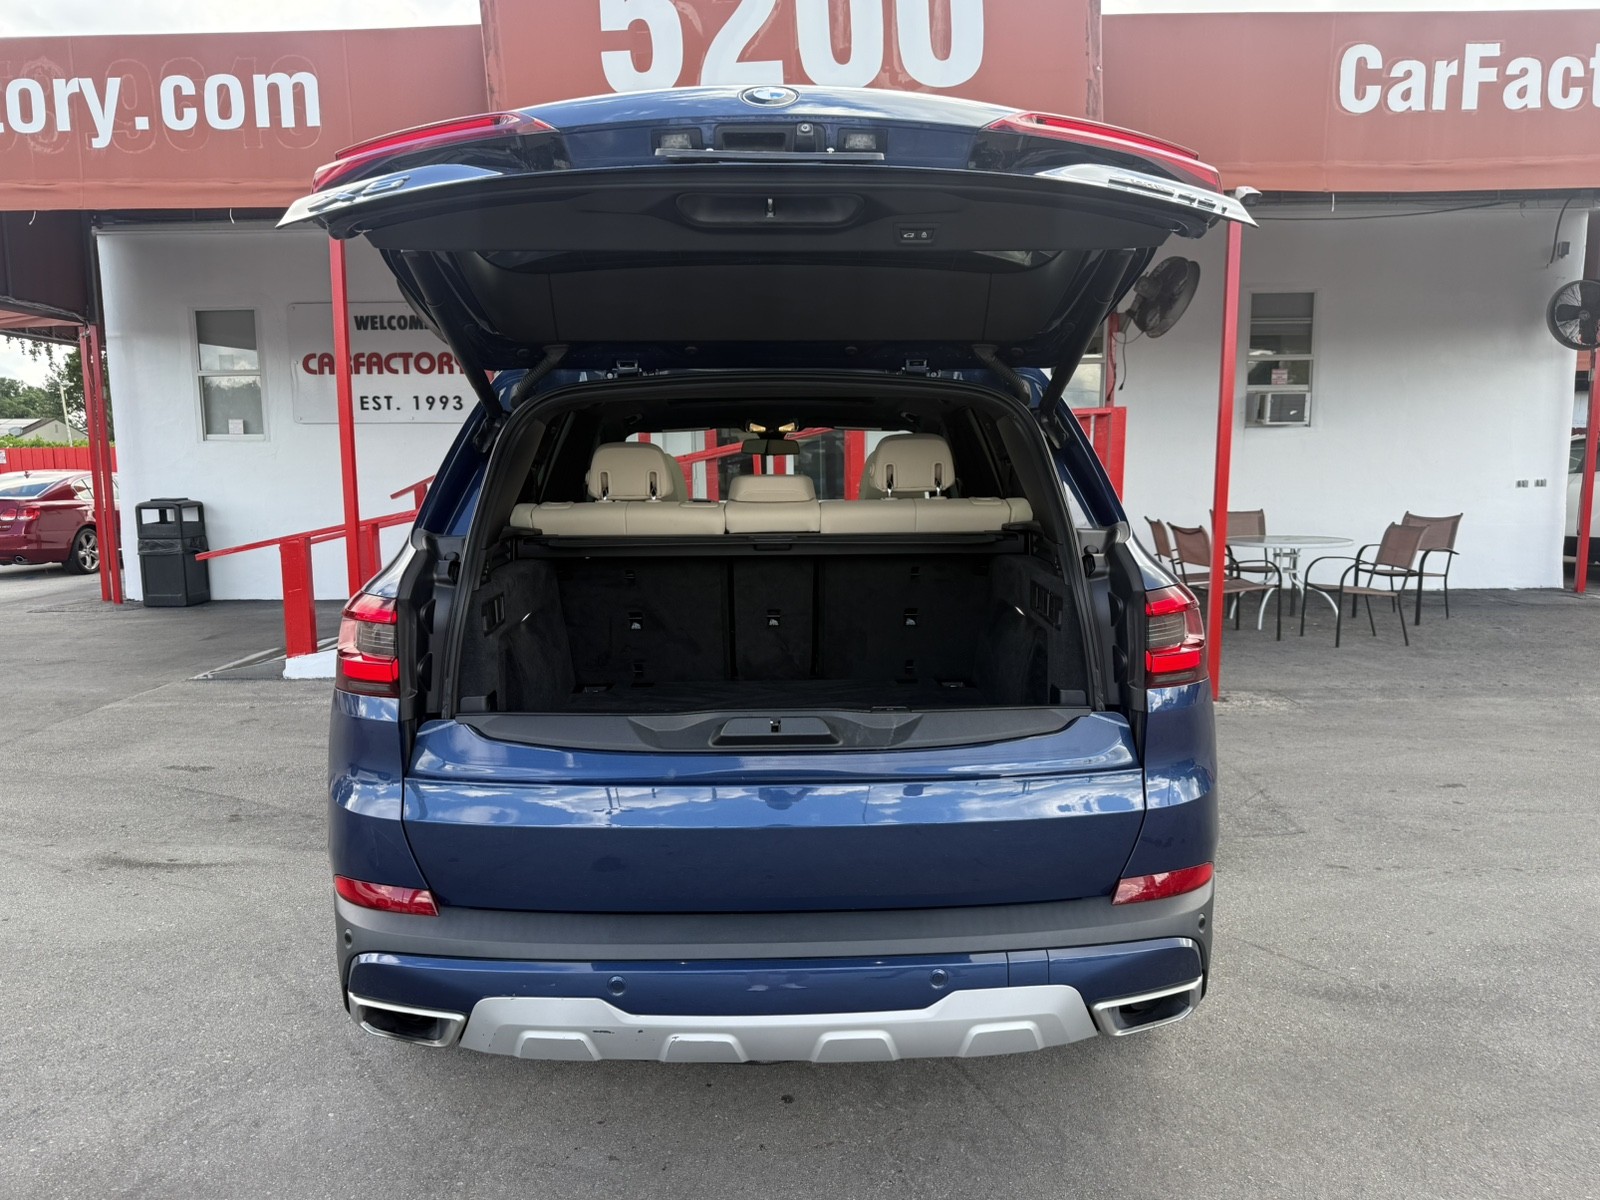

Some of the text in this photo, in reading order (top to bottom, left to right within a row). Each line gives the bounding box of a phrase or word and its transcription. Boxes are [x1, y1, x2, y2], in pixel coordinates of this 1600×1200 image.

[599, 0, 984, 92] 5200
[0, 71, 321, 149] ory.com
[353, 315, 430, 331] WELCOM
[302, 352, 465, 375] CAFACTOR
[360, 395, 464, 411] EST. 1993
